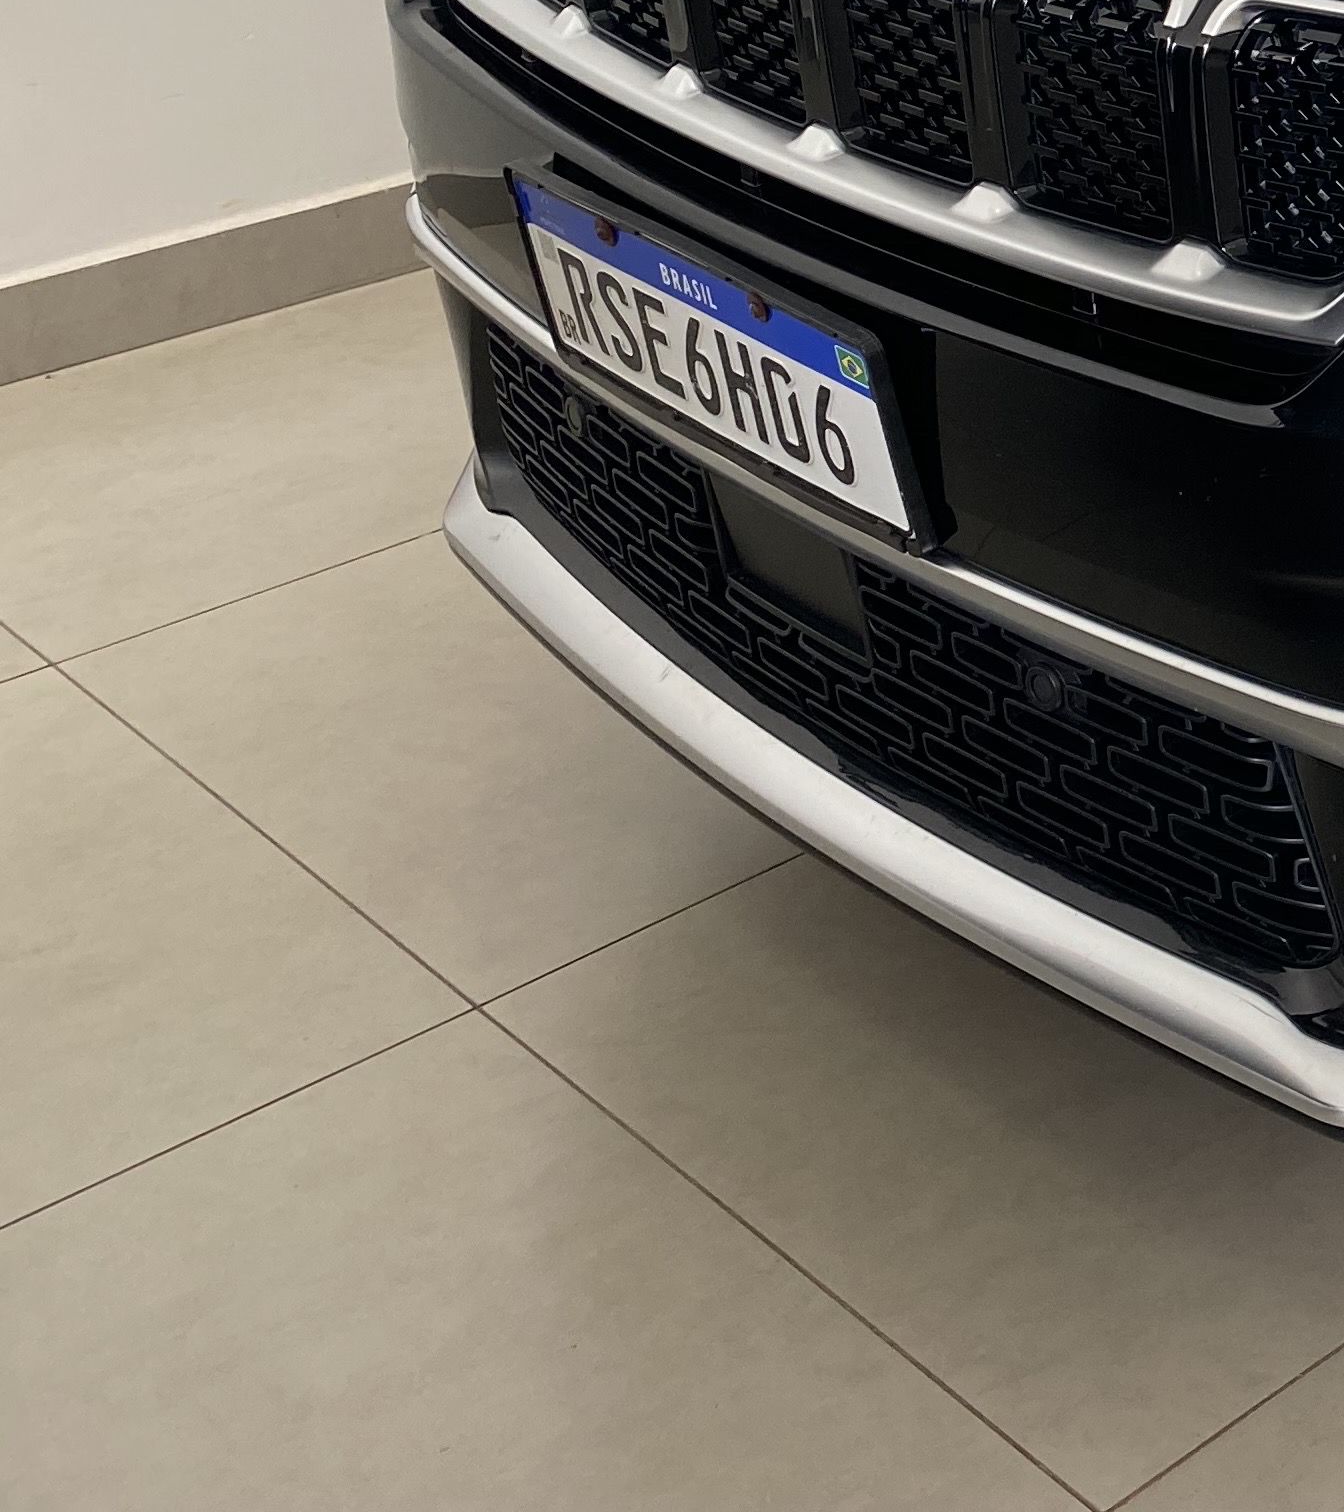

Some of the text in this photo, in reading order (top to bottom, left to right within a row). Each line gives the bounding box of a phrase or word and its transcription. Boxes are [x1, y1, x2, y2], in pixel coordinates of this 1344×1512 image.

[659, 262, 718, 310] BRASIL
[559, 309, 579, 345] BR
[558, 248, 856, 486] RSE6H06
